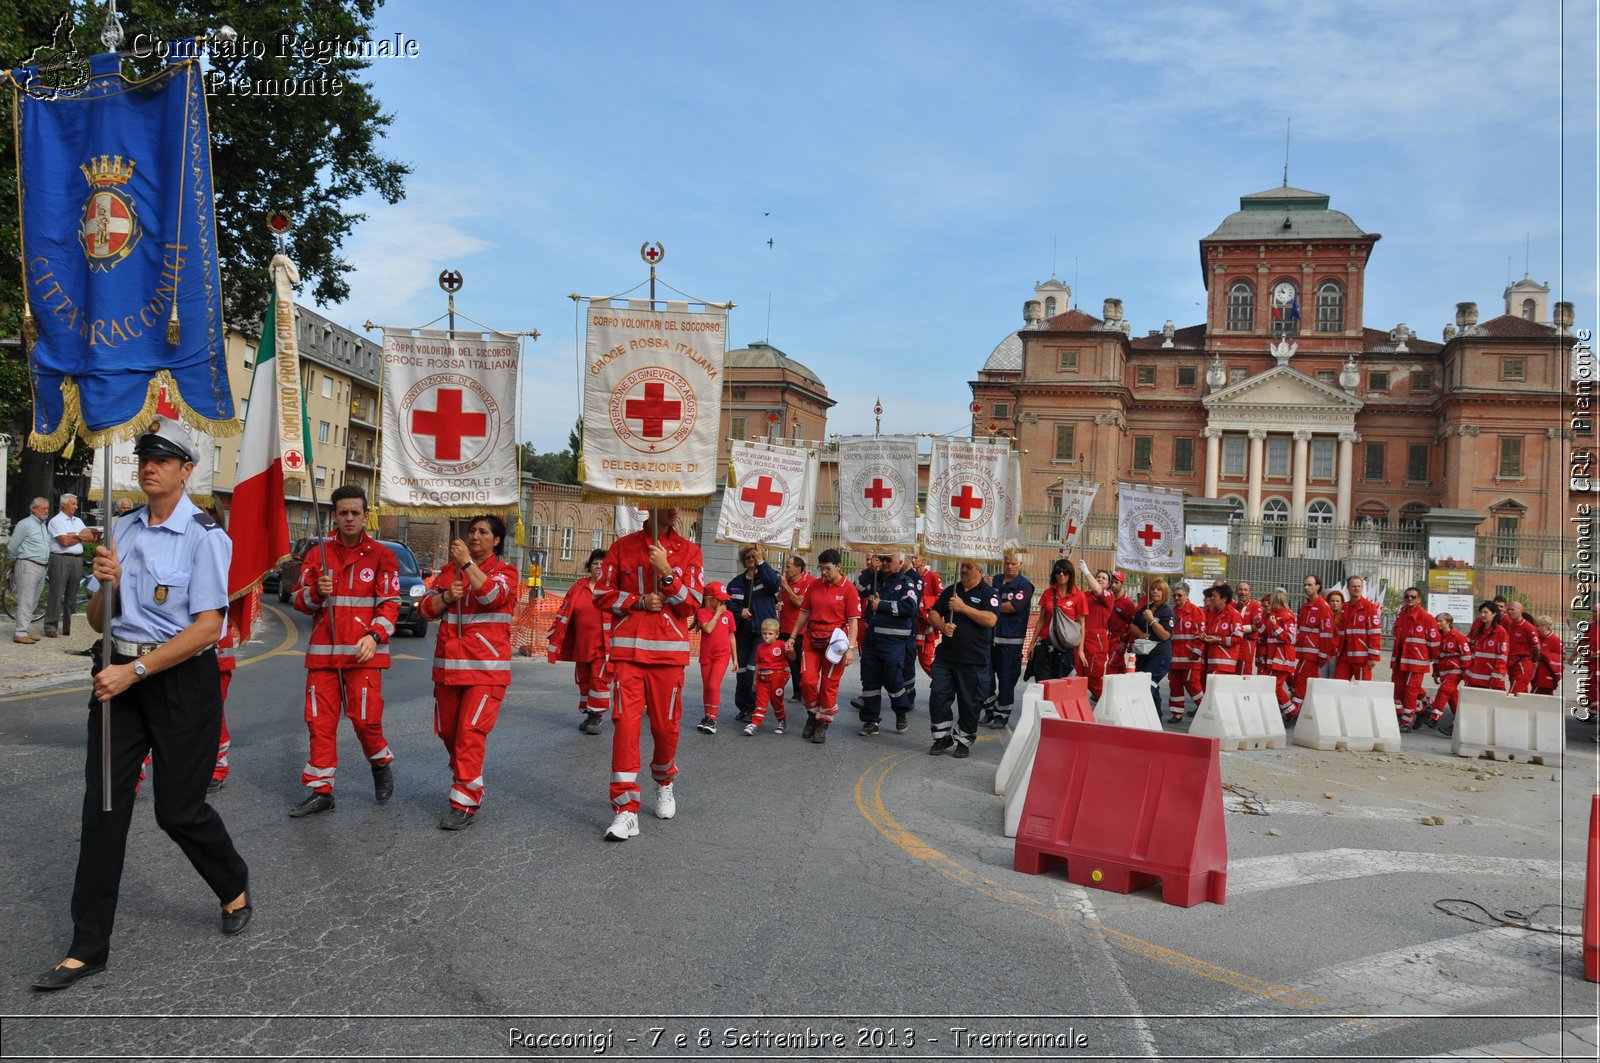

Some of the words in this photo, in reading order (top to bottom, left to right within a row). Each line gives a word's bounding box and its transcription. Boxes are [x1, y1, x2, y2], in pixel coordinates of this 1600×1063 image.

[90, 243, 188, 348] RACCONIGI
[276, 300, 292, 340] CUNEO
[593, 315, 618, 328] CORPO
[621, 318, 662, 330] VOLONTARI
[664, 320, 678, 331] DEL
[681, 321, 720, 333] SOCCORSO
[391, 342, 414, 353] CORPO
[416, 345, 455, 357] VOLONTARI
[458, 347, 472, 357] DEL
[476, 348, 511, 357] SOCCORSO
[385, 354, 423, 367] CROCE
[427, 359, 465, 369] ROSSA
[469, 360, 518, 370] ITALIANA
[590, 344, 626, 375] CROCE
[630, 337, 670, 349] ROSSA
[675, 342, 718, 381] ITALIANA
[627, 375, 638, 385] DI
[637, 369, 676, 383] GINEVRA
[675, 378, 687, 391] 22
[401, 375, 454, 411] CONVENZIONE
[458, 376, 468, 384] DI
[469, 381, 498, 415] GINEVRA
[279, 387, 300, 441] COMITATO
[611, 381, 631, 440] CONVENZIONE
[683, 389, 695, 426] AGOSTO
[673, 426, 690, 442] 1864
[602, 459, 682, 473] DELEGAZIONE
[687, 463, 698, 473] DI
[754, 460, 777, 470] ROSSA
[392, 475, 444, 487] COMITATO
[448, 477, 491, 487] LOCALE
[494, 477, 504, 486] DI
[615, 477, 683, 492] PAESANA
[930, 468, 950, 496] CROCE
[950, 461, 979, 473] ROSSA
[980, 466, 1005, 500] ITALIANA
[409, 490, 490, 502] RACCONIGI
[1135, 503, 1159, 512] ROSSA
[731, 522, 775, 534] DELEGAZIONE
[930, 531, 961, 541] COMITATO
[963, 535, 990, 543] LOCALE
[926, 539, 951, 549] BORGO
[961, 543, 1001, 553] DALMAZZO
